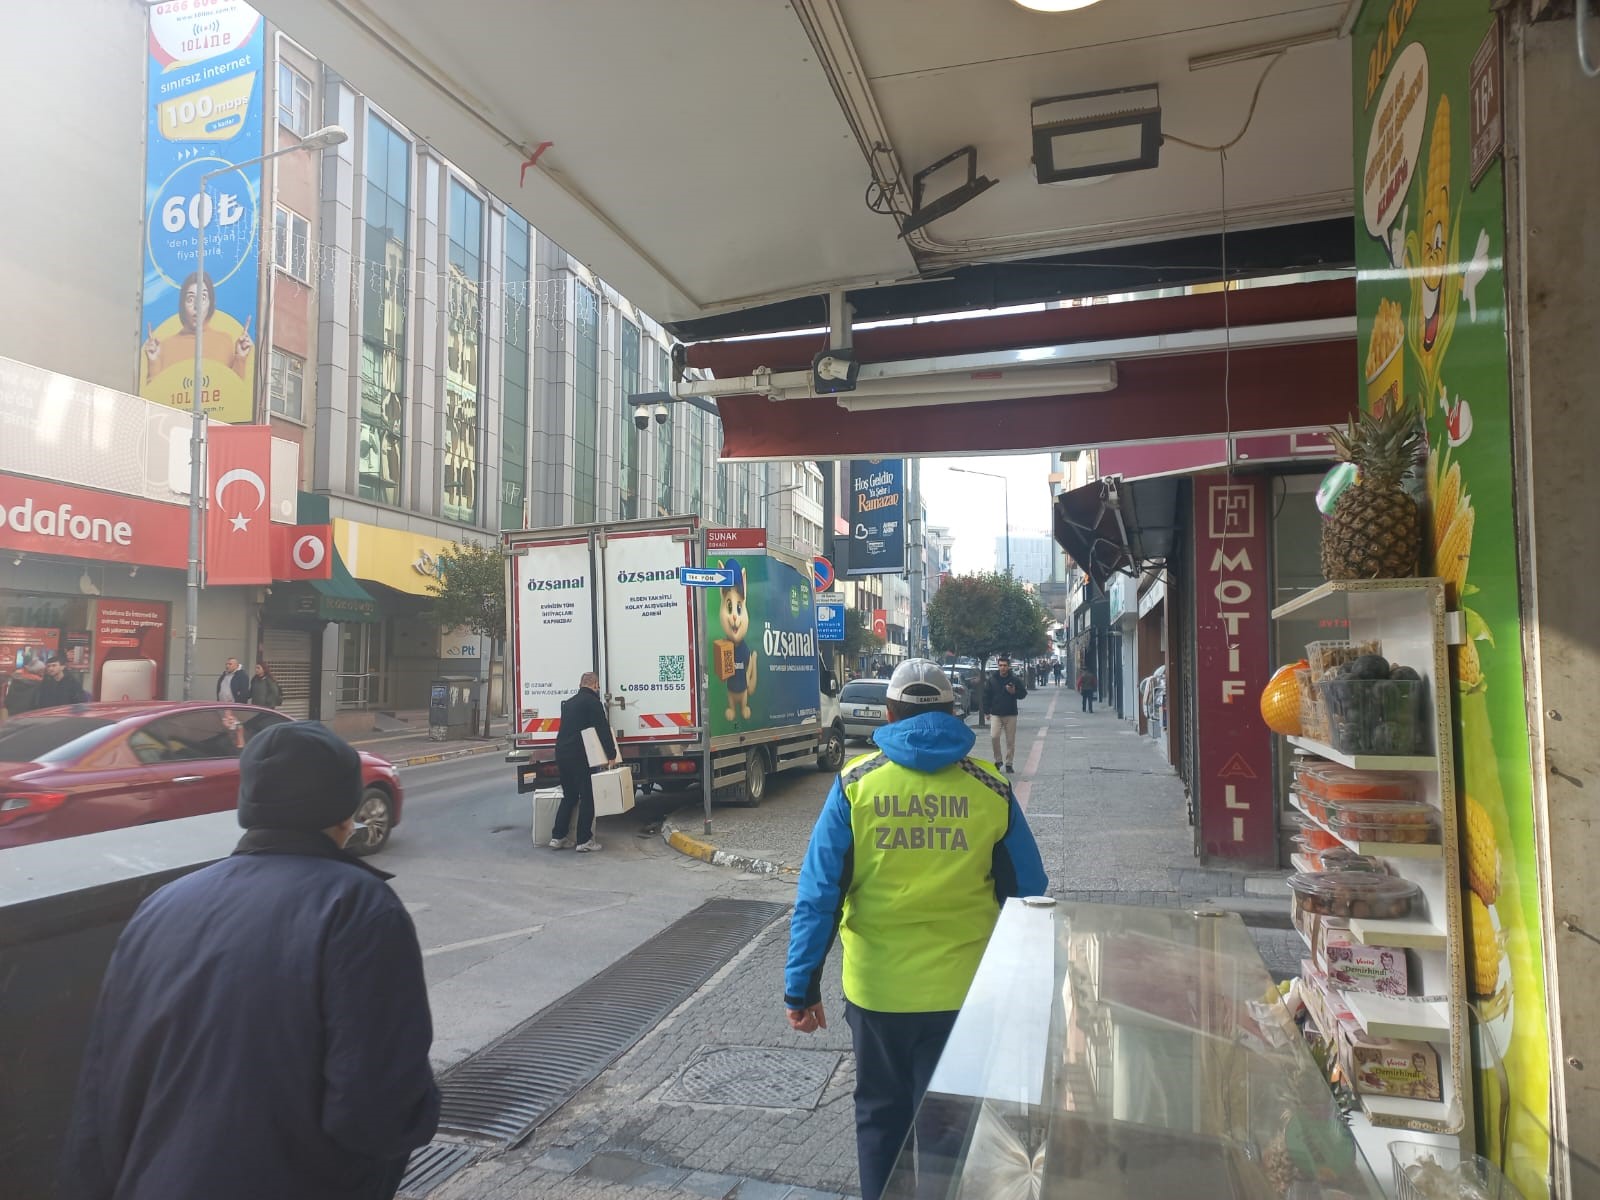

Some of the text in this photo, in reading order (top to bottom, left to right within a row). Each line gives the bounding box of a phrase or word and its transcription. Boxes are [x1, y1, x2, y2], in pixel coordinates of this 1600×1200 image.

[160, 54, 251, 94] sınırsız internet
[167, 96, 214, 128] 100
[191, 233, 236, 246] bşlayan
[177, 248, 222, 261] fiyatarla
[170, 389, 221, 404] 10Lne
[855, 471, 894, 492] Hoş Geldin
[858, 493, 899, 513] Ramazan
[0, 498, 132, 545] dafone
[708, 532, 737, 541] SUNAK
[763, 621, 815, 660] Özşanal
[461, 645, 476, 656] Ptt
[628, 684, 649, 692] 0850
[664, 683, 675, 691] 55
[676, 683, 686, 691] 55
[874, 796, 969, 822] ULAŞIM
[875, 827, 969, 851] ZABITA
[1345, 965, 1387, 977] Demirhindi
[1375, 1068, 1420, 1079] Demirhindi
